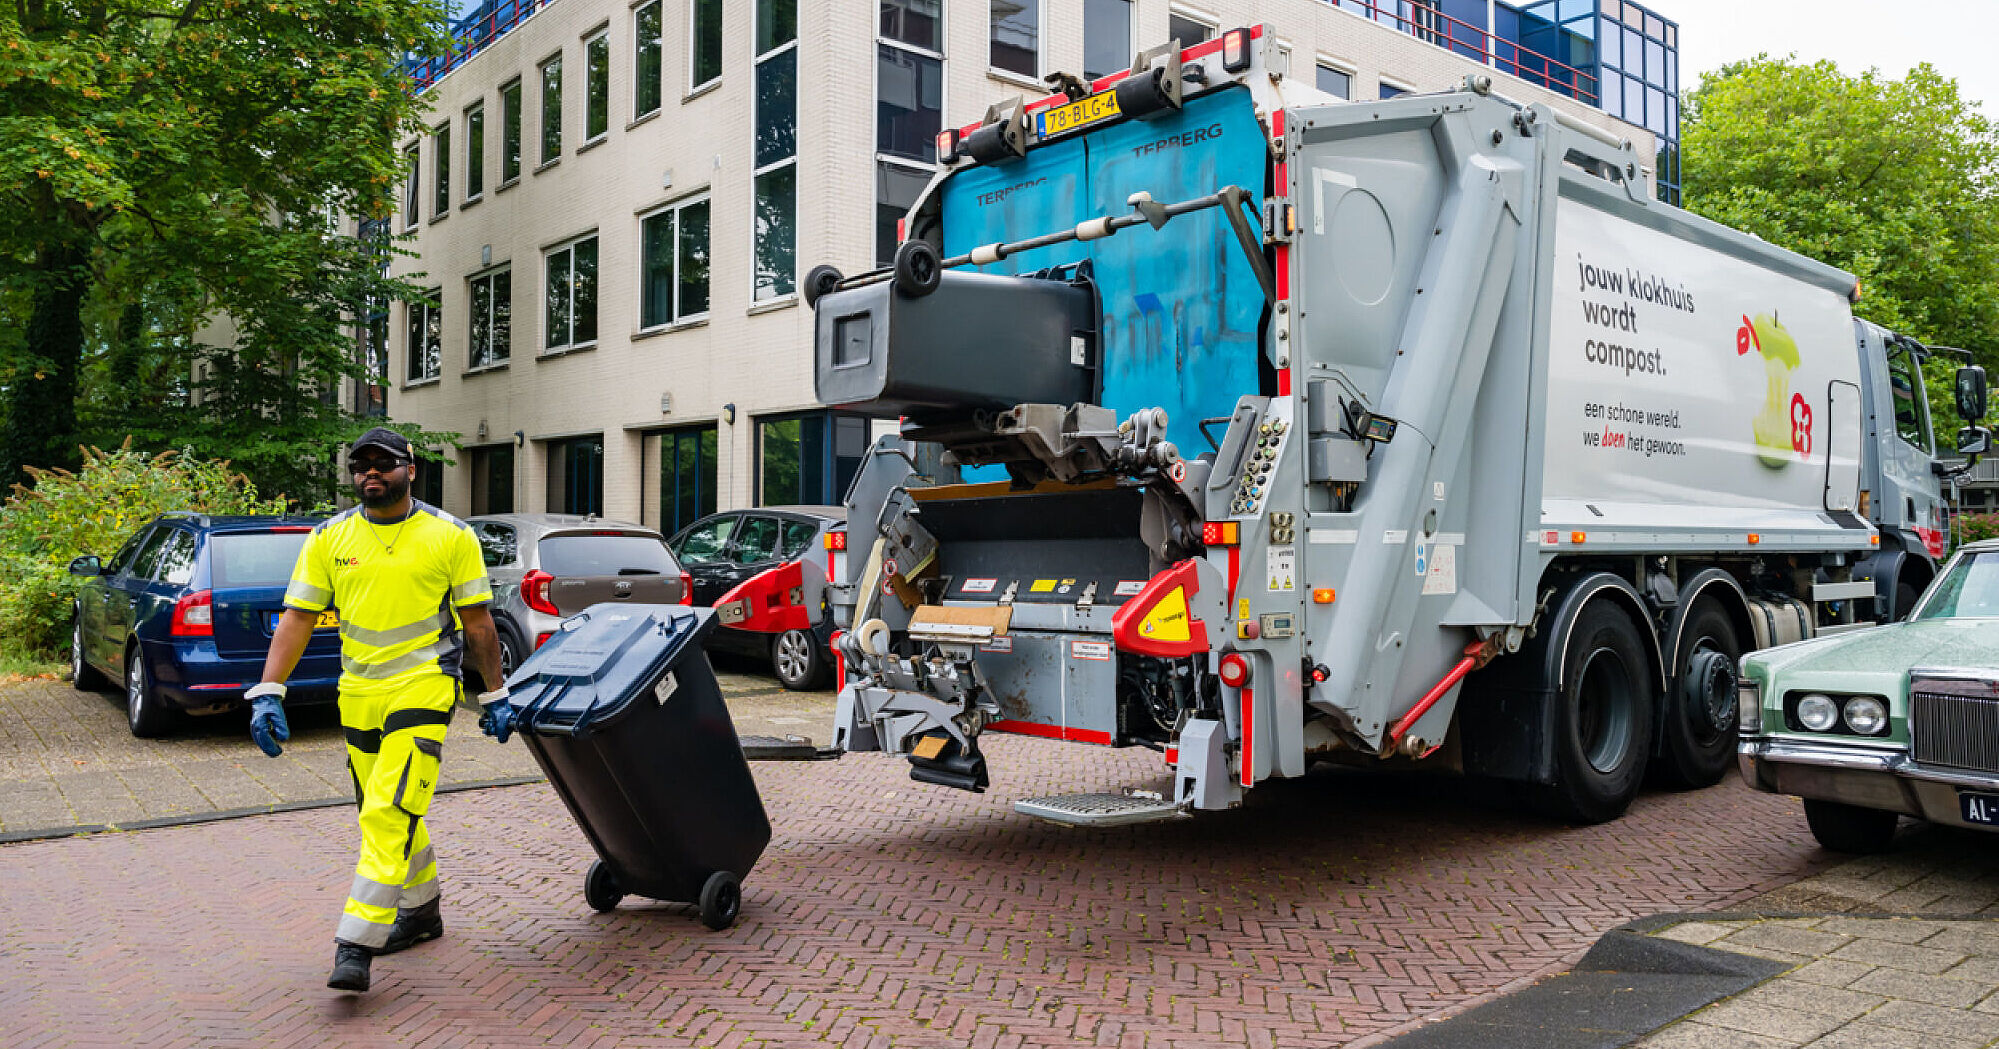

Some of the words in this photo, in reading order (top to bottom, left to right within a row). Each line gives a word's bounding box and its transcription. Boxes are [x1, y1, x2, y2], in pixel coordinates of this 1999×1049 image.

[1049, 94, 1115, 131] 78-BLG-4
[1577, 251, 1622, 294] jouw
[1626, 267, 1695, 314] klokhuis
[1582, 299, 1638, 334] wordt
[1585, 338, 1667, 376] compost.
[1584, 402, 1605, 418] een
[1607, 401, 1645, 424] schone
[1646, 409, 1681, 429] wereld.
[1582, 431, 1600, 447] we
[1601, 424, 1626, 449] doen
[1627, 431, 1645, 452] het
[1645, 438, 1687, 458] gewoon.
